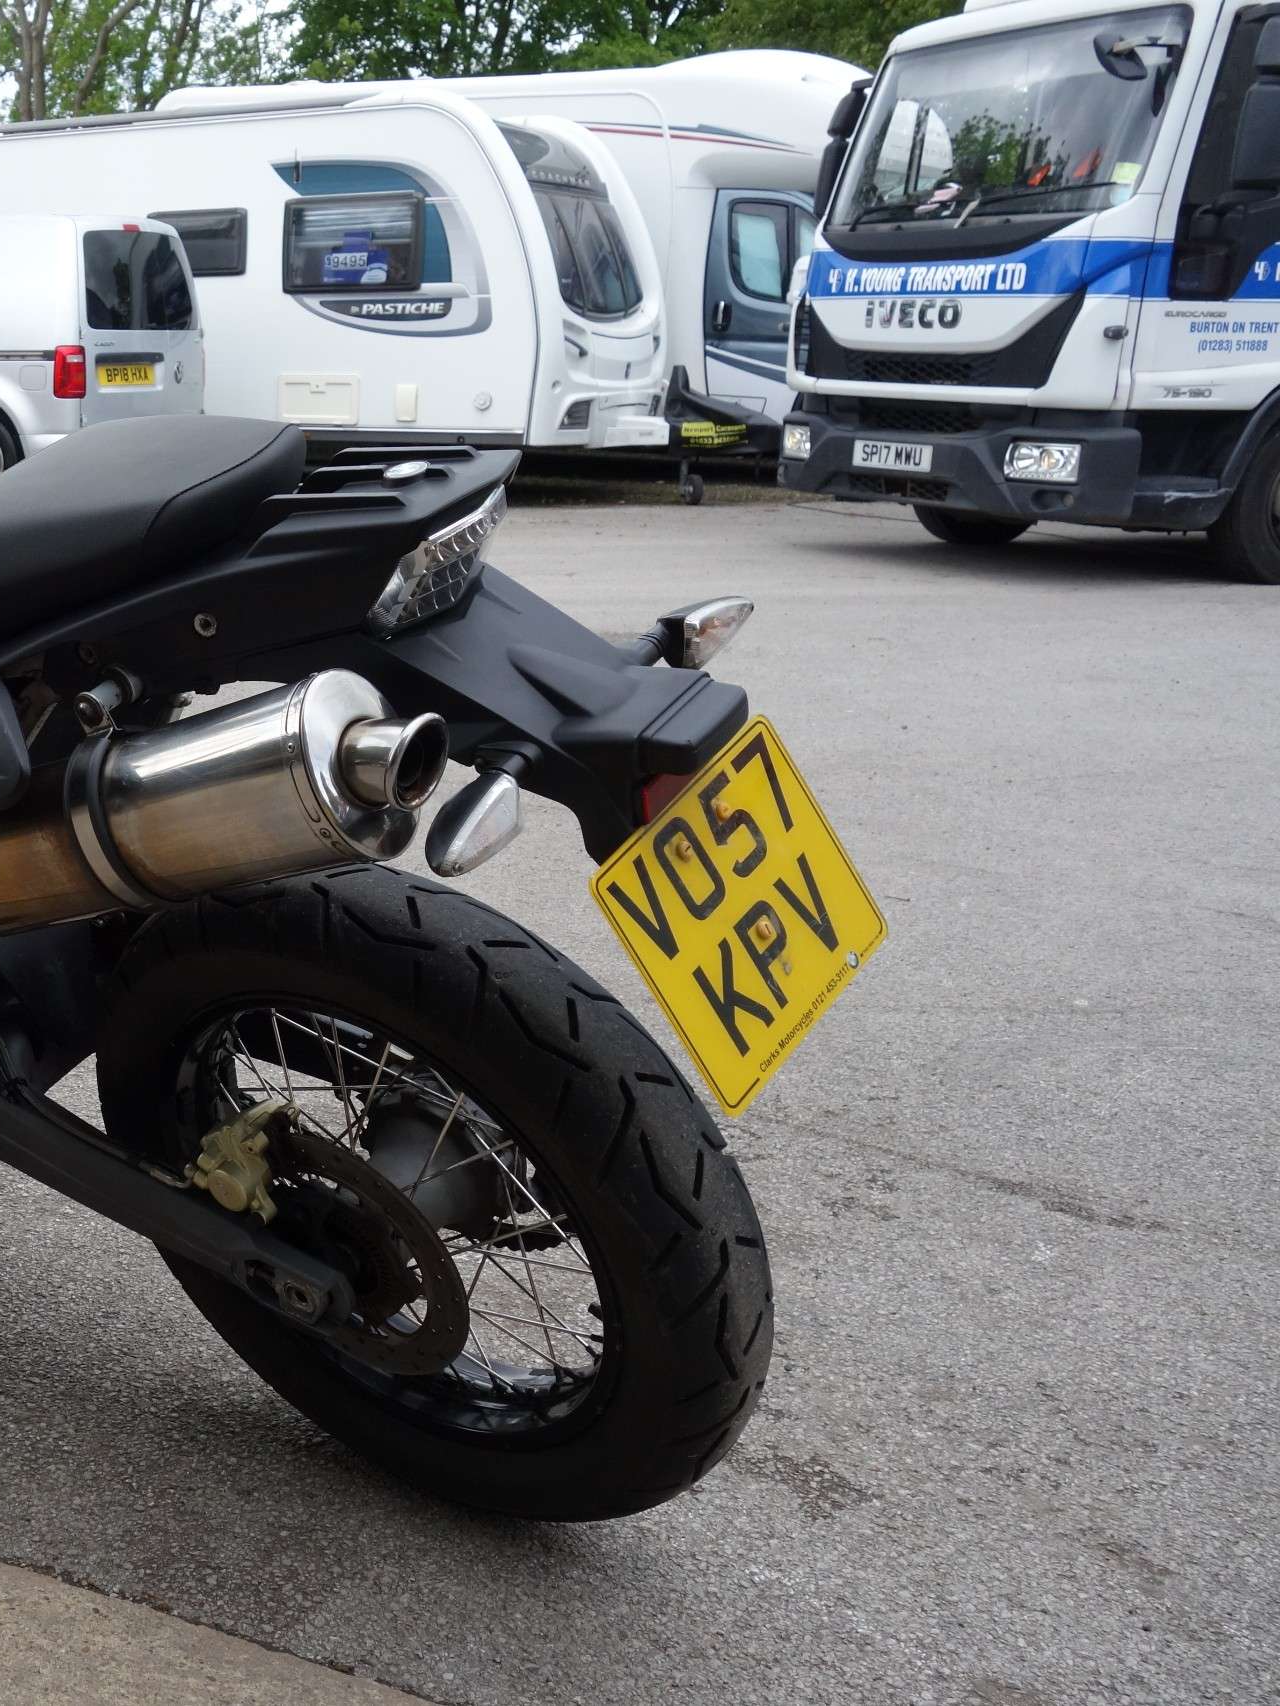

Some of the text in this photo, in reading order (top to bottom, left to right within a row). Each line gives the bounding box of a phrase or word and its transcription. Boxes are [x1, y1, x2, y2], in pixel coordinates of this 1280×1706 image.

[906, 264, 996, 292] TRANSPORT
[996, 262, 1027, 291] LTD
[361, 302, 445, 315] PASTICHE
[864, 299, 963, 329] IVECO
[1189, 321, 1280, 333] BURTON ON TRENT
[1198, 339, 1269, 353] (01283) 511888
[105, 367, 149, 383] BP18 HXA
[862, 444, 923, 467] SP17 MWU
[606, 731, 794, 960] VO57
[691, 852, 840, 1058] KPV
[759, 1048, 780, 1073] Clarks
[778, 1009, 814, 1050] Motorcycles
[812, 991, 828, 1011] 0121
